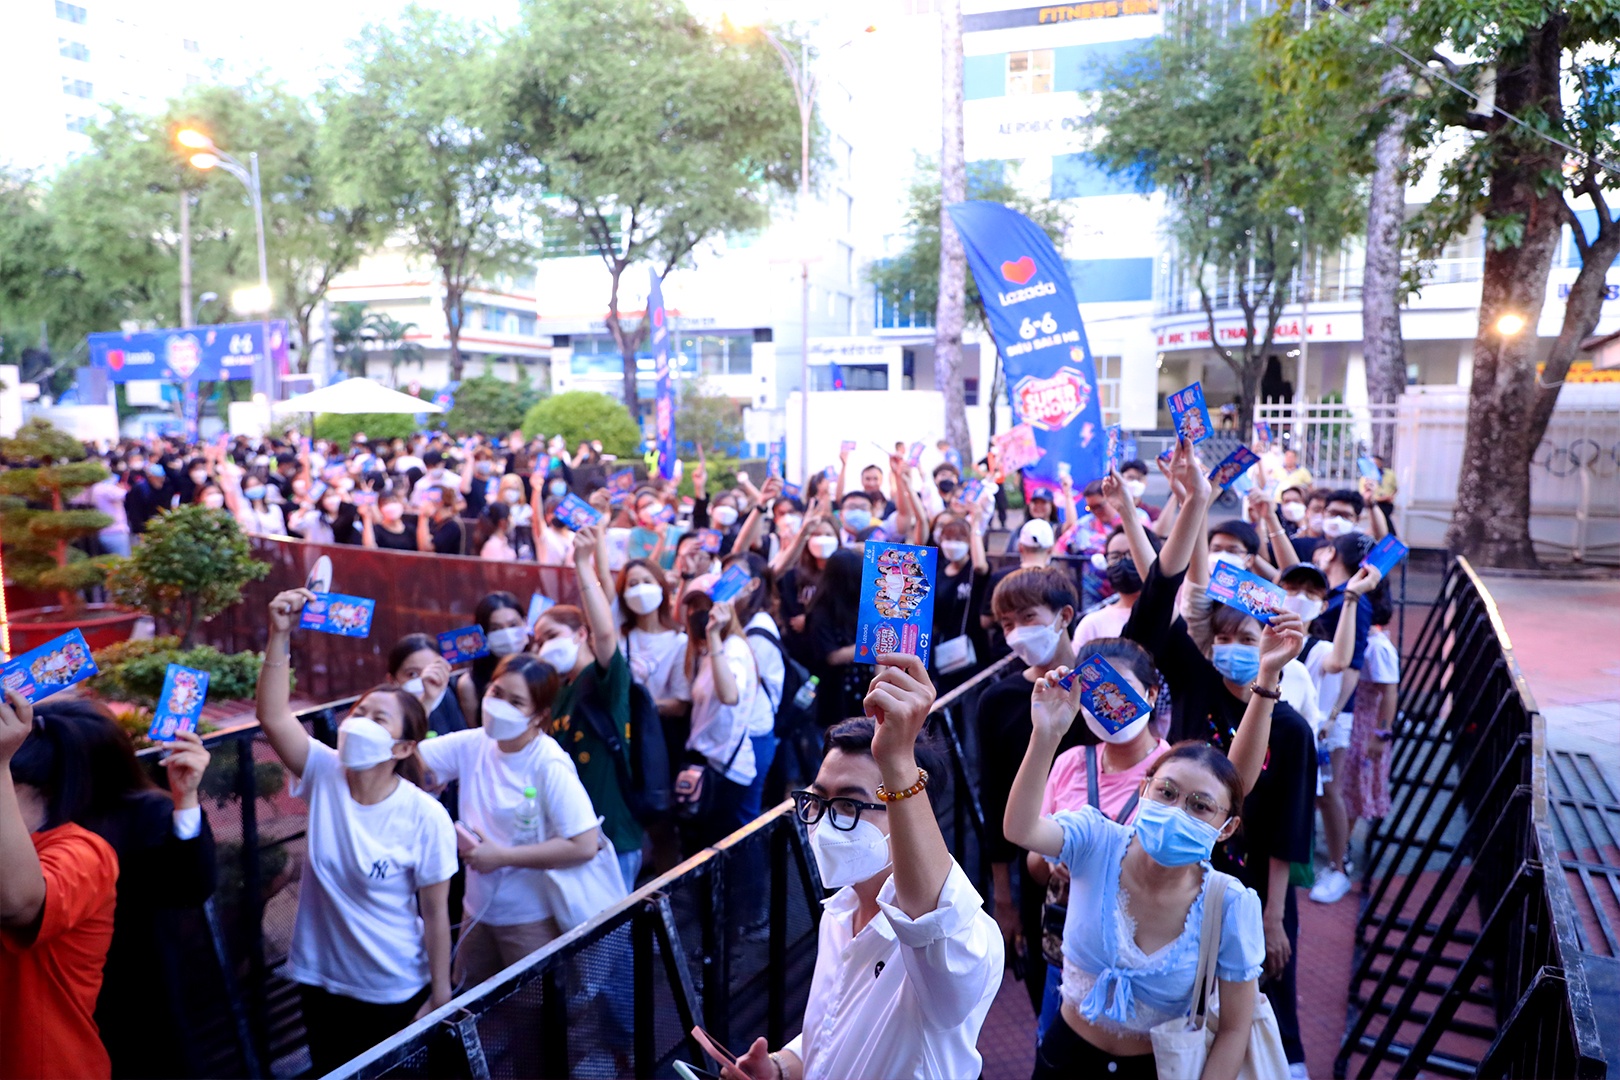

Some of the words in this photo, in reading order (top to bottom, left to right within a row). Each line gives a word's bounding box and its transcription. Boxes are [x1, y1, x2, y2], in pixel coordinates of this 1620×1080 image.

[1039, 1, 1118, 24] FITNESS
[998, 281, 1057, 307] Lazada
[861, 623, 869, 644] Lazada
[880, 628, 889, 653] SUPER
[919, 633, 930, 649] C2
